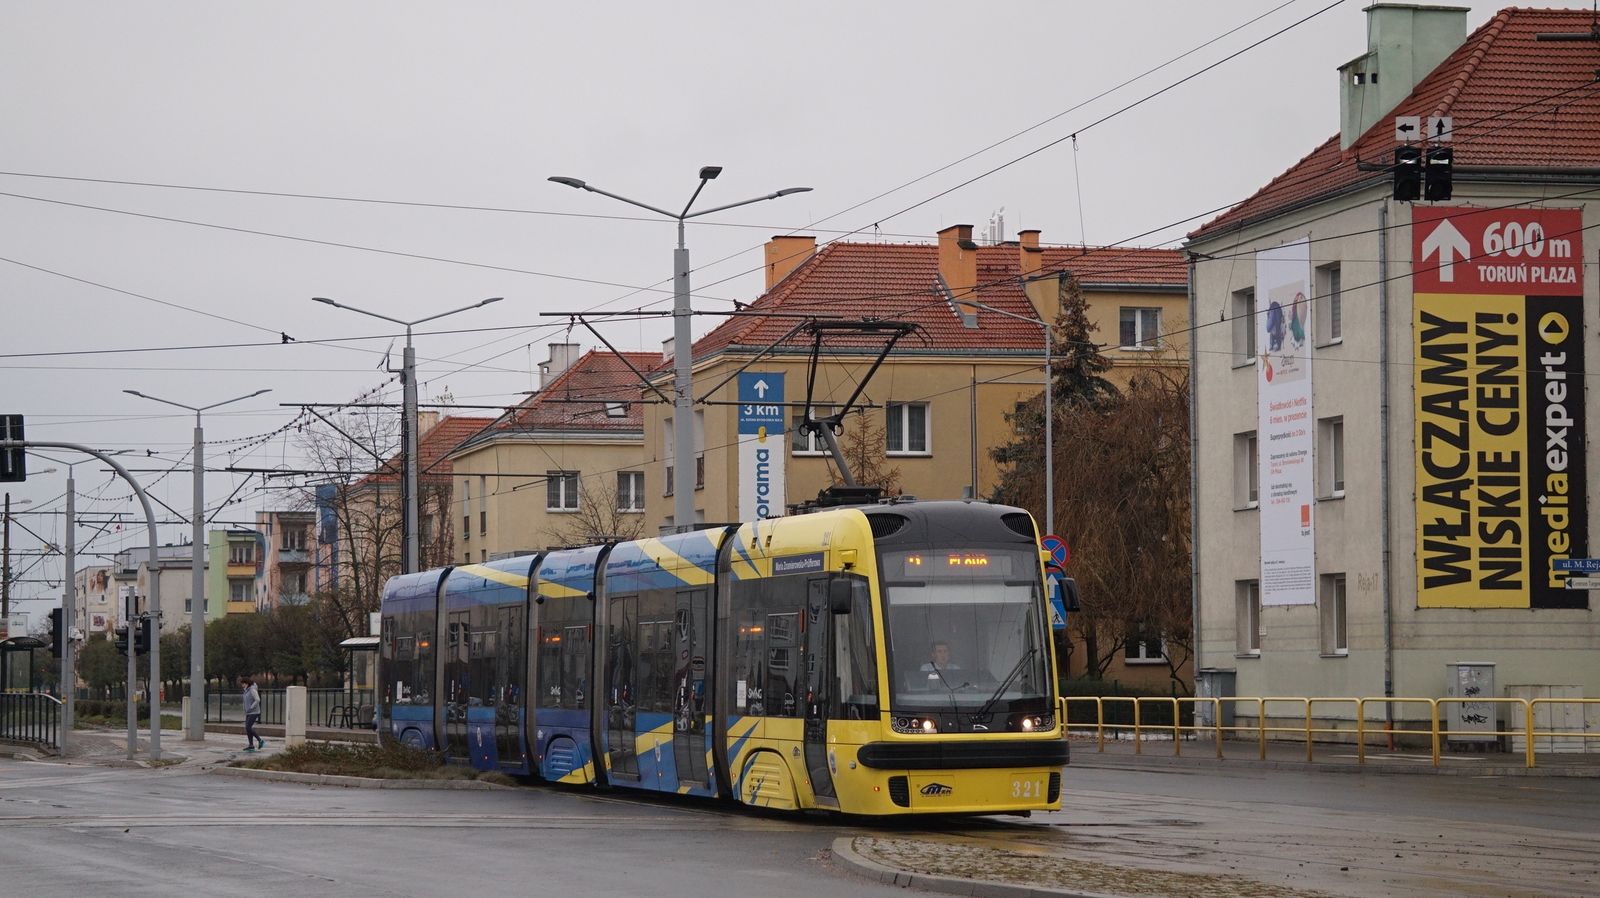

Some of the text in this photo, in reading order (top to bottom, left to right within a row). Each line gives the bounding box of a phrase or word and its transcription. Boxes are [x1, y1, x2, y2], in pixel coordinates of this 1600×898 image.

[1482, 222, 1571, 258] 600 m
[1477, 263, 1577, 284] TORUŃ PLAZA
[744, 404, 779, 416] 3 km
[1420, 310, 1474, 590] WŁĄCZAMY
[1475, 312, 1522, 590] NISKIE CENY!
[1538, 351, 1574, 588] mediaexpert
[756, 449, 769, 521] orama
[1012, 780, 1041, 798] 321
